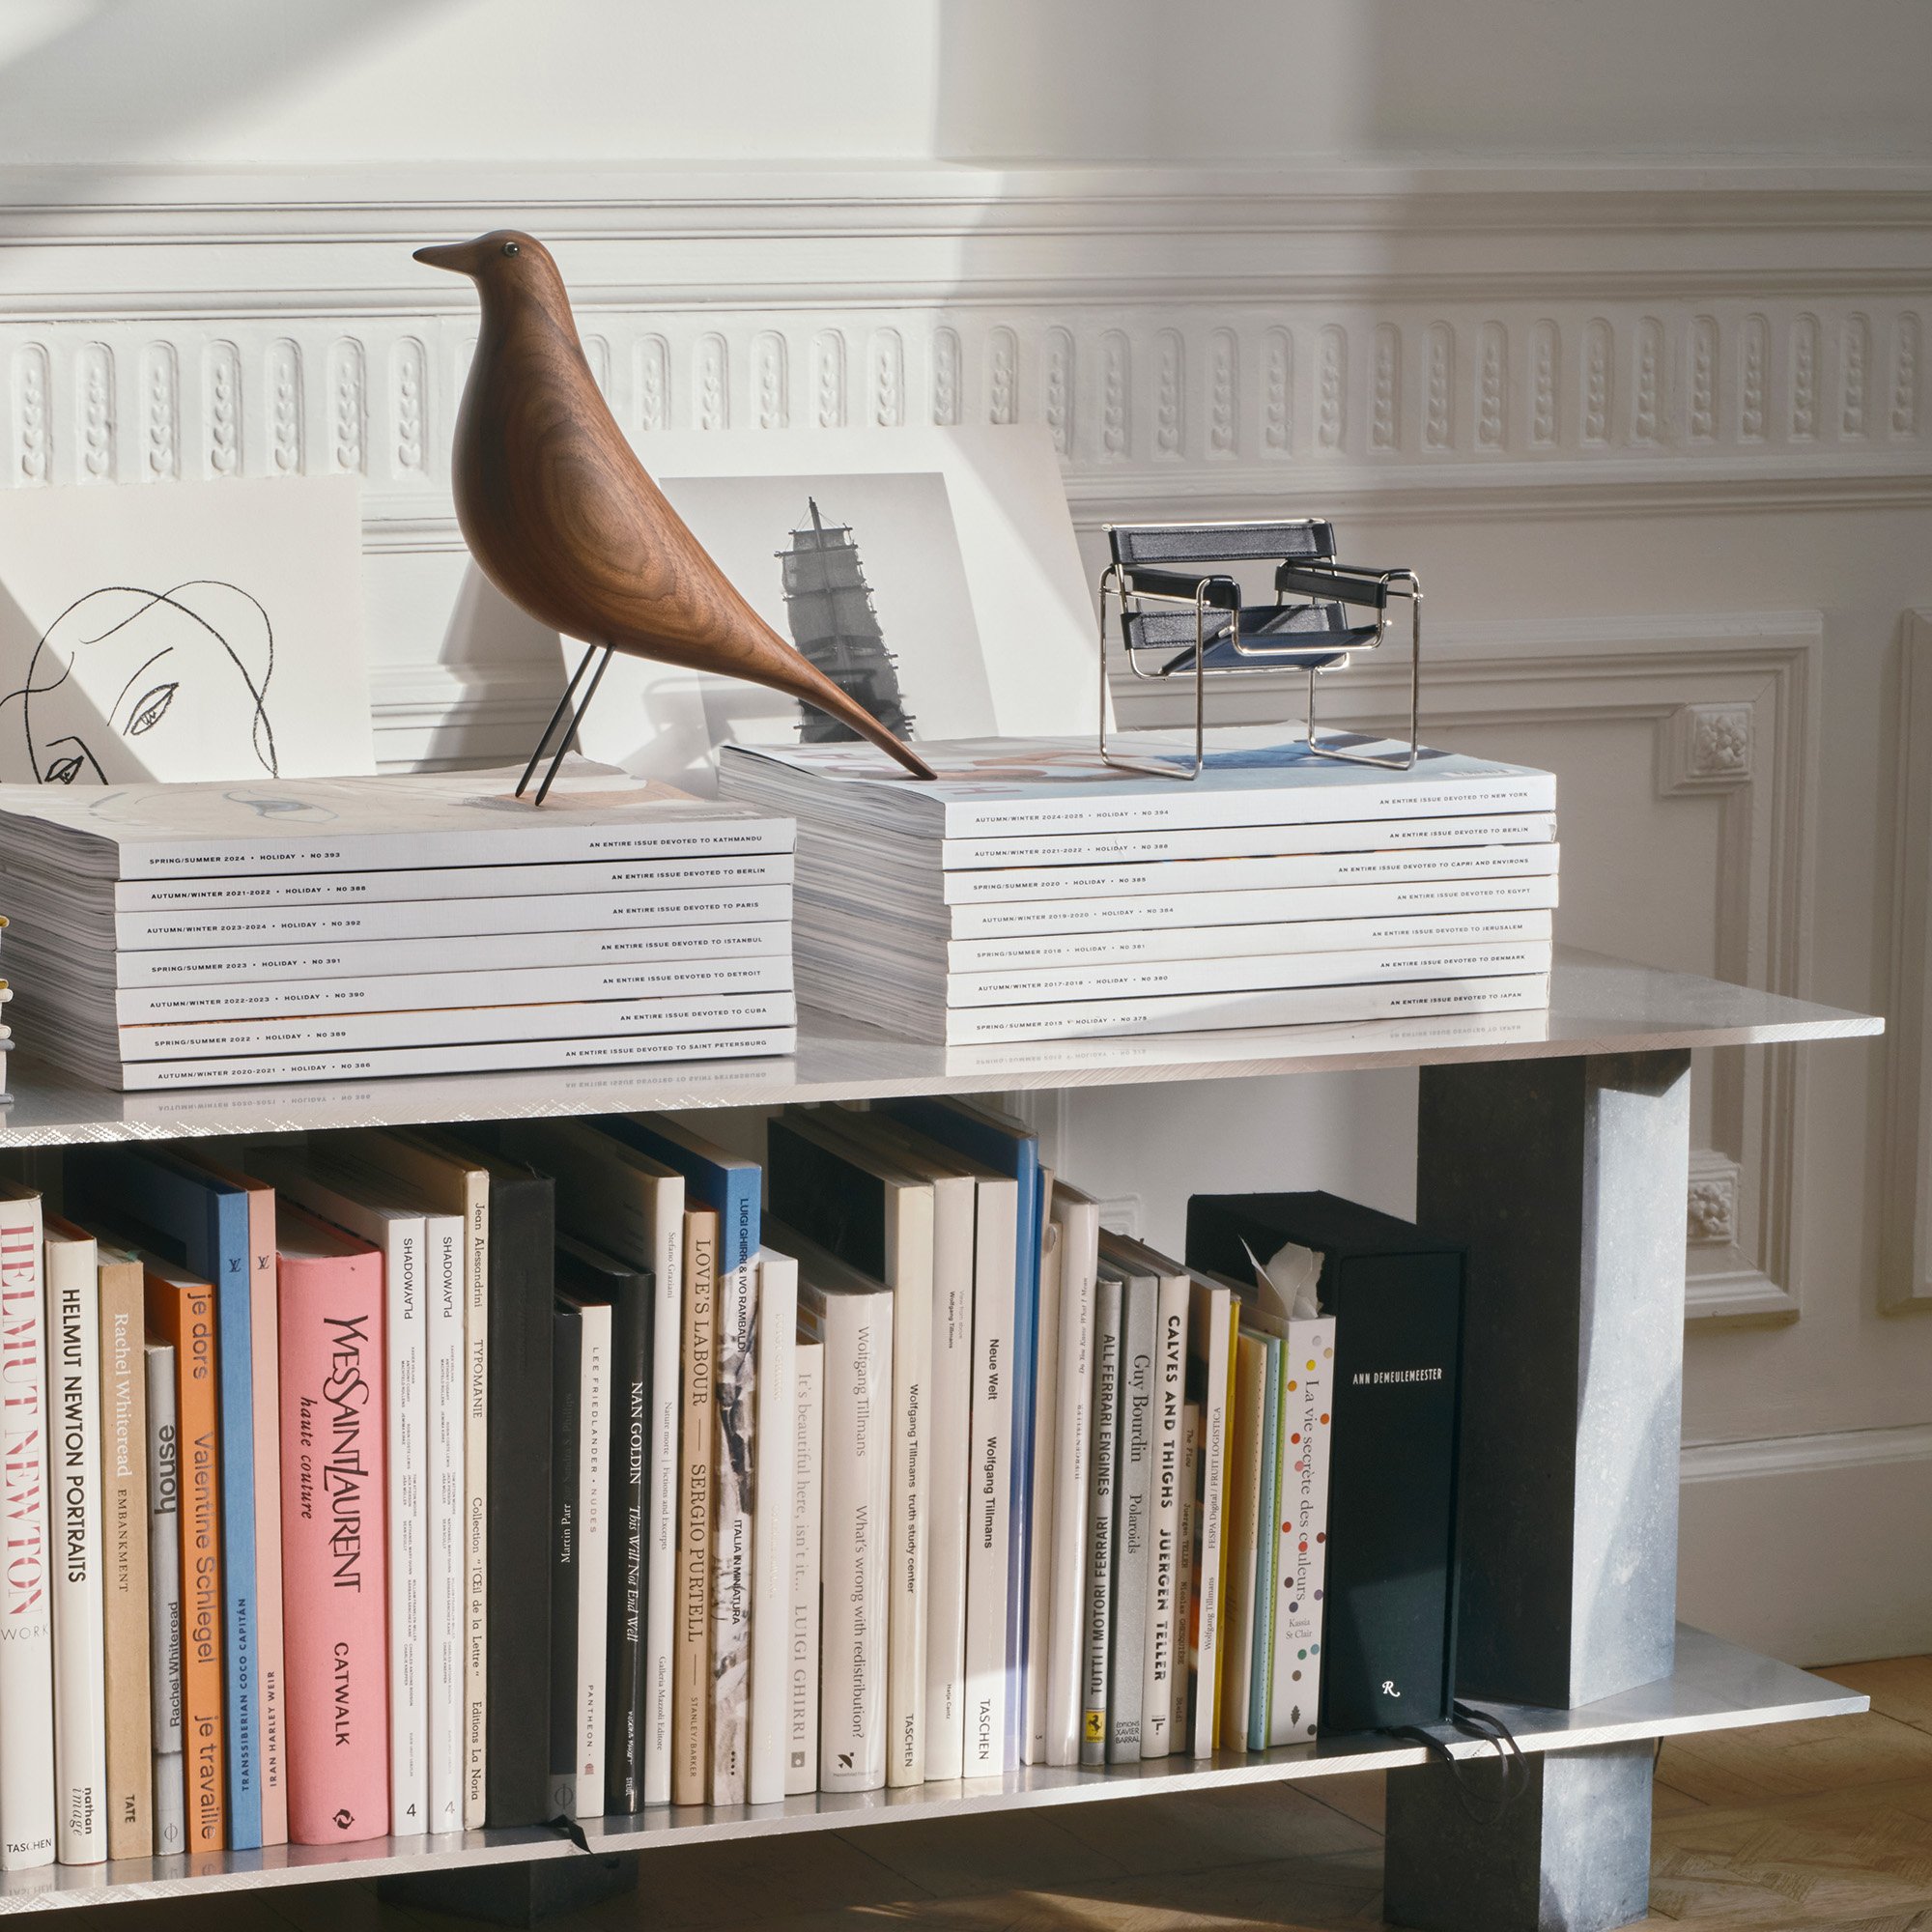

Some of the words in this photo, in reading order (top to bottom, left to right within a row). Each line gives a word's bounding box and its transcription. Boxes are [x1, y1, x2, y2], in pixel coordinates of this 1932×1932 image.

[149, 856, 221, 866] SPRING/SUMMER
[474, 1202, 485, 1231] Jean
[739, 1198, 749, 1227] LUIGI
[666, 1232, 676, 1263] Stefano
[738, 1228, 748, 1264] GHIRRI
[738, 1265, 747, 1274] &
[474, 1236, 485, 1308] Alessandrini
[665, 1263, 676, 1299] Graziani
[694, 1239, 712, 1315] LOVE'S
[737, 1275, 747, 1294] IVO
[0, 1224, 37, 1415] HELMUT
[62, 1289, 82, 1368] HELMUT
[186, 1293, 213, 1316] je
[736, 1295, 747, 1353] RAMBALDI
[114, 1312, 131, 1377] Rachel
[191, 1322, 213, 1379] dors
[692, 1320, 710, 1406] LABOUR
[852, 1325, 869, 1396] Wolfgang
[988, 1338, 1000, 1371] Neue
[1101, 1334, 1115, 1361] ALL
[1165, 1315, 1180, 1383] CALVES
[472, 1338, 483, 1419] TYPOMANIE
[797, 1373, 812, 1399] It's
[987, 1373, 999, 1401] Welt
[1098, 1364, 1113, 1427] FERRARI
[1127, 1353, 1151, 1391] Guy
[1303, 1380, 1316, 1402] La
[1352, 1373, 1371, 1385] ANN
[1373, 1367, 1443, 1384] DEMEULEMEESTER
[64, 1376, 84, 1467] NEWTON
[299, 1396, 319, 1447] haute
[631, 1380, 643, 1419] NAN
[906, 1383, 919, 1438] Wolfgang
[1163, 1390, 1177, 1432] AND
[1302, 1408, 1314, 1433] vie
[115, 1379, 133, 1478] Whiteread
[590, 1377, 599, 1473] FRIEDLANDER
[796, 1404, 812, 1475] beautiful
[854, 1397, 870, 1458] Tillmans
[1130, 1394, 1150, 1463] Bourdin
[154, 1424, 176, 1515] house
[629, 1422, 643, 1486] GOLDIN
[908, 1439, 919, 1489] Tillmans
[982, 1436, 997, 1494] Wolfgang
[1096, 1432, 1111, 1496] ENGINES
[1160, 1439, 1176, 1509] THIGHS
[1299, 1436, 1313, 1495] secrète
[193, 1432, 213, 1549] Valentine
[299, 1454, 314, 1520] couture
[589, 1488, 598, 1533] NUDES
[689, 1463, 707, 1542] SERGIO
[794, 1480, 811, 1520] here,
[908, 1493, 917, 1521] truth
[6, 1430, 43, 1615] NEWTON
[66, 1475, 87, 1583] PORTRAITS
[471, 1496, 483, 1554] Collection
[560, 1503, 571, 1525] Parr
[626, 1505, 639, 1531] This
[733, 1520, 743, 1553] ITALIA
[855, 1505, 868, 1553] What's
[983, 1496, 996, 1549] Tillmans
[1127, 1493, 1143, 1554] Polaroids
[1298, 1499, 1312, 1528] des
[117, 1489, 128, 1593] EMBANKMENT
[560, 1528, 571, 1563] Martin
[626, 1534, 639, 1561] Will
[733, 1554, 742, 1566] IN
[795, 1524, 810, 1558] isn't
[905, 1523, 917, 1555] study
[1093, 1516, 1108, 1578] FERRARI
[626, 1564, 639, 1586] Not
[849, 1556, 865, 1603] wrong
[907, 1557, 916, 1594] center
[1156, 1528, 1172, 1611] JUERGEN
[192, 1556, 216, 1663] Schlegel
[471, 1599, 483, 1614] de
[626, 1590, 639, 1614] End
[688, 1548, 705, 1643] PURTELL
[731, 1567, 742, 1625] MINIATURA
[1092, 1585, 1105, 1641] MOTORI
[1, 1624, 48, 1640] WORK
[167, 1601, 179, 1675] Whiteread
[236, 1598, 247, 1651] CAPITÁN
[471, 1618, 483, 1631] la
[625, 1616, 639, 1643] Well
[793, 1605, 808, 1662] LUIGI
[853, 1605, 867, 1636] with
[239, 1655, 248, 1690] COCO
[1089, 1656, 1102, 1695] TUTTI
[1153, 1621, 1168, 1681] TELLER
[168, 1679, 180, 1728] Rachel
[267, 1671, 275, 1702] WEIR
[333, 1641, 351, 1747] CATWALK
[792, 1668, 807, 1741] GHIRRI
[852, 1640, 867, 1739] redistribution?
[194, 1715, 217, 1738] je
[240, 1694, 250, 1792] TRANSSIBERIAN
[268, 1707, 276, 1752] HARLEY
[471, 1701, 483, 1744] Editions
[689, 1696, 698, 1777] STANLEY/BARKER
[904, 1713, 915, 1768] TASCHEN
[979, 1698, 991, 1760] TASCHEN
[269, 1756, 277, 1787] IRAN
[471, 1747, 482, 1763] La
[125, 1794, 136, 1824] TATE
[199, 1743, 219, 1840] travaille
[470, 1768, 482, 1802] Noria
[69, 1788, 85, 1836] image
[84, 1787, 95, 1835] nathan
[6, 1838, 52, 1853] TASCHEN
